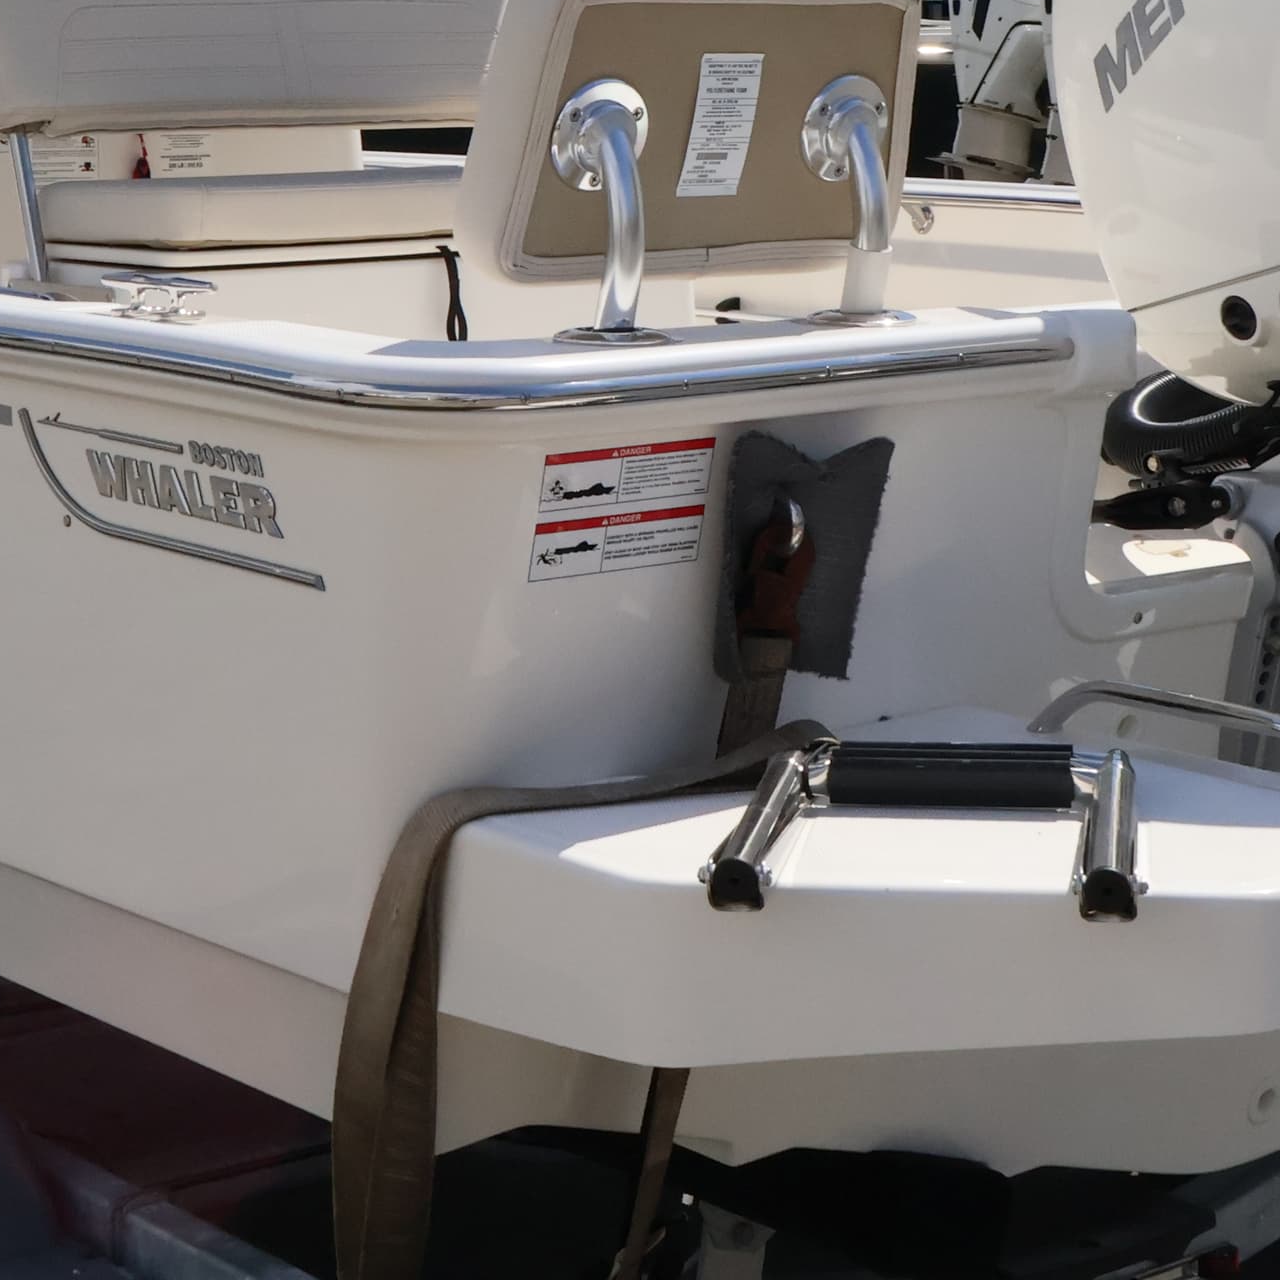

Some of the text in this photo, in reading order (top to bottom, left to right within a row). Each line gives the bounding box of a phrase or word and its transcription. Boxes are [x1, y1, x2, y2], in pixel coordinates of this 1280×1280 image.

[187, 439, 265, 478] BOSTON
[619, 446, 652, 457] DANGER
[85, 448, 285, 539] WHALER
[609, 514, 642, 525] DANGER
